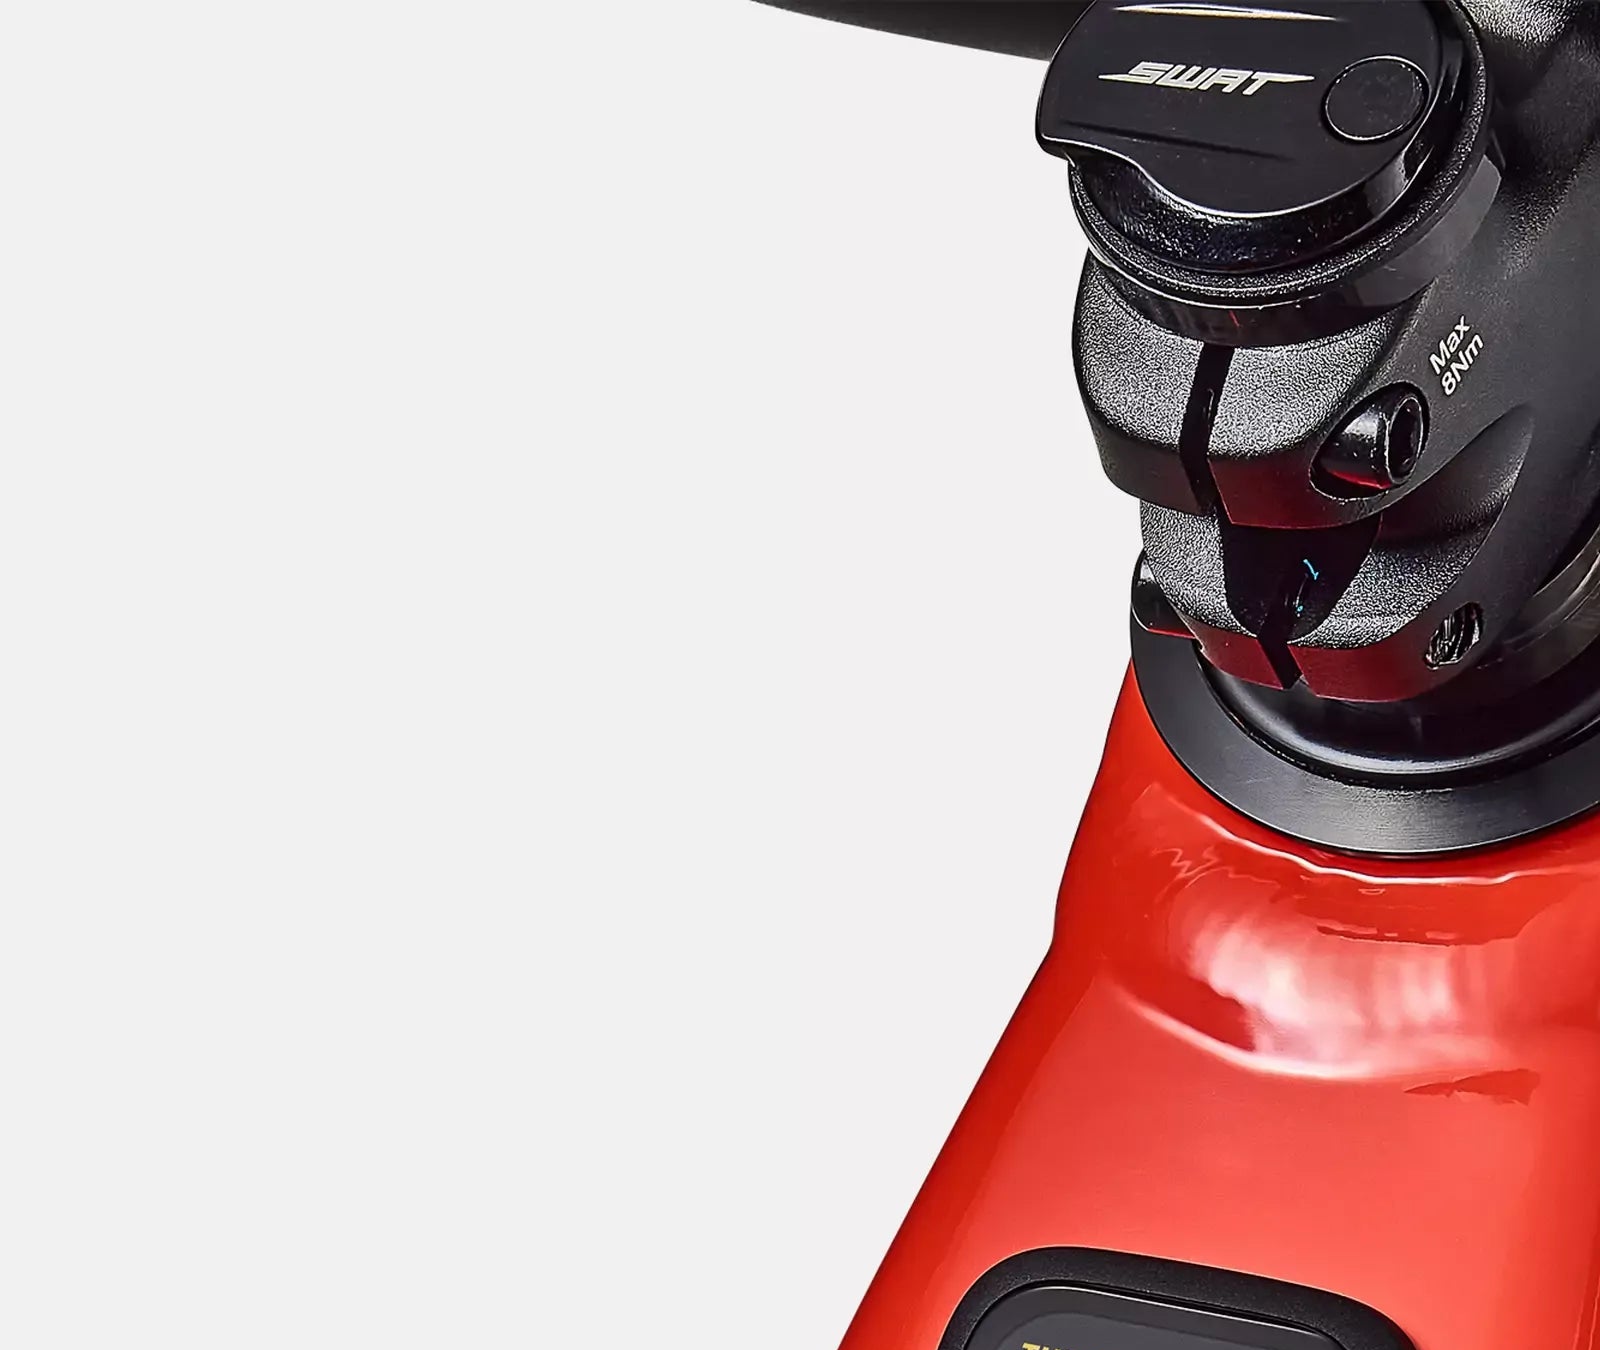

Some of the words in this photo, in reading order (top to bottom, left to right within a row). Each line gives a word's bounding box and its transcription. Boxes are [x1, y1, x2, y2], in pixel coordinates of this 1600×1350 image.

[1099, 61, 1315, 95] SWAT
[1429, 315, 1471, 375] Max
[1441, 334, 1484, 396] 8Nm
